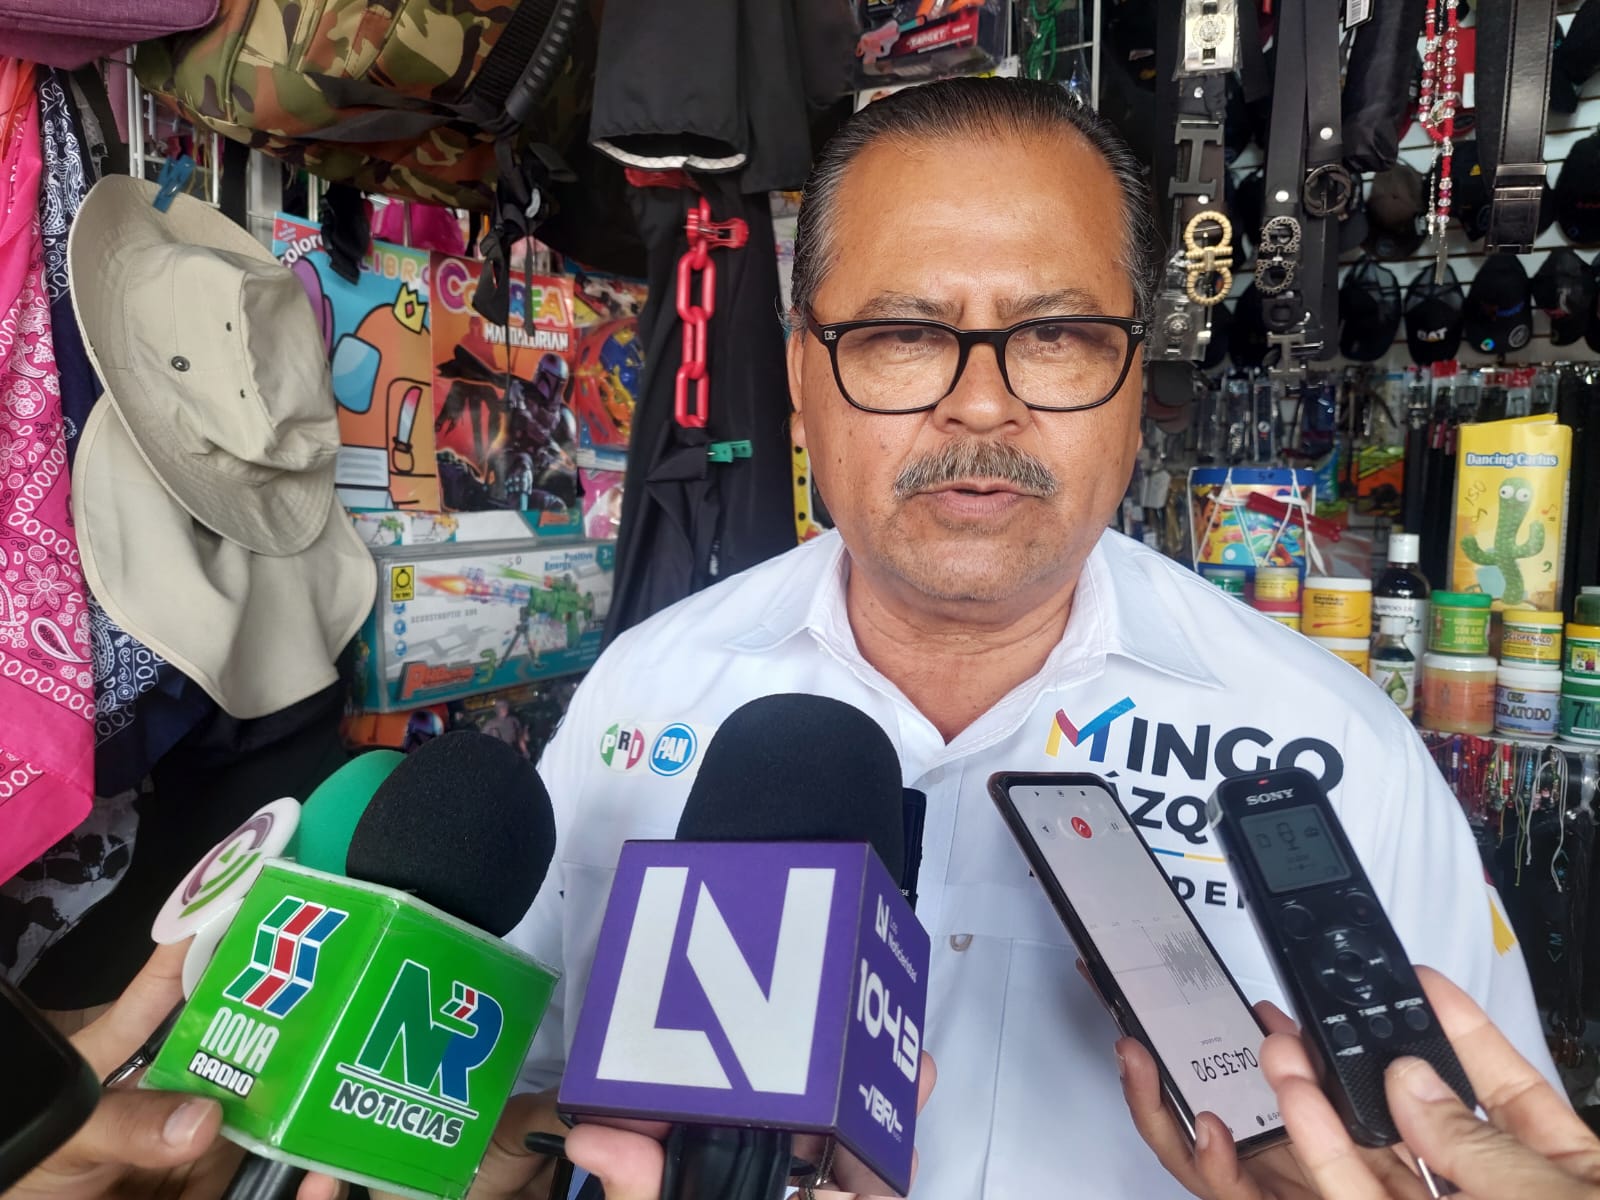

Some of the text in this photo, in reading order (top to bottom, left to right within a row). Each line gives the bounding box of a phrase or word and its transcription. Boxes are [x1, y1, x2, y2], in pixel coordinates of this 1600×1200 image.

[1466, 452, 1558, 469] Dancing Cactus
[1572, 702, 1584, 727] 7
[601, 730, 641, 759] PRI
[654, 735, 690, 763] PAN
[1045, 696, 1344, 792] MINGO
[1246, 788, 1295, 806] SONY
[200, 1007, 280, 1073] NOVA
[355, 959, 504, 1105] NR
[189, 1052, 254, 1097] RADIO
[331, 1081, 465, 1148] NOTICIAS
